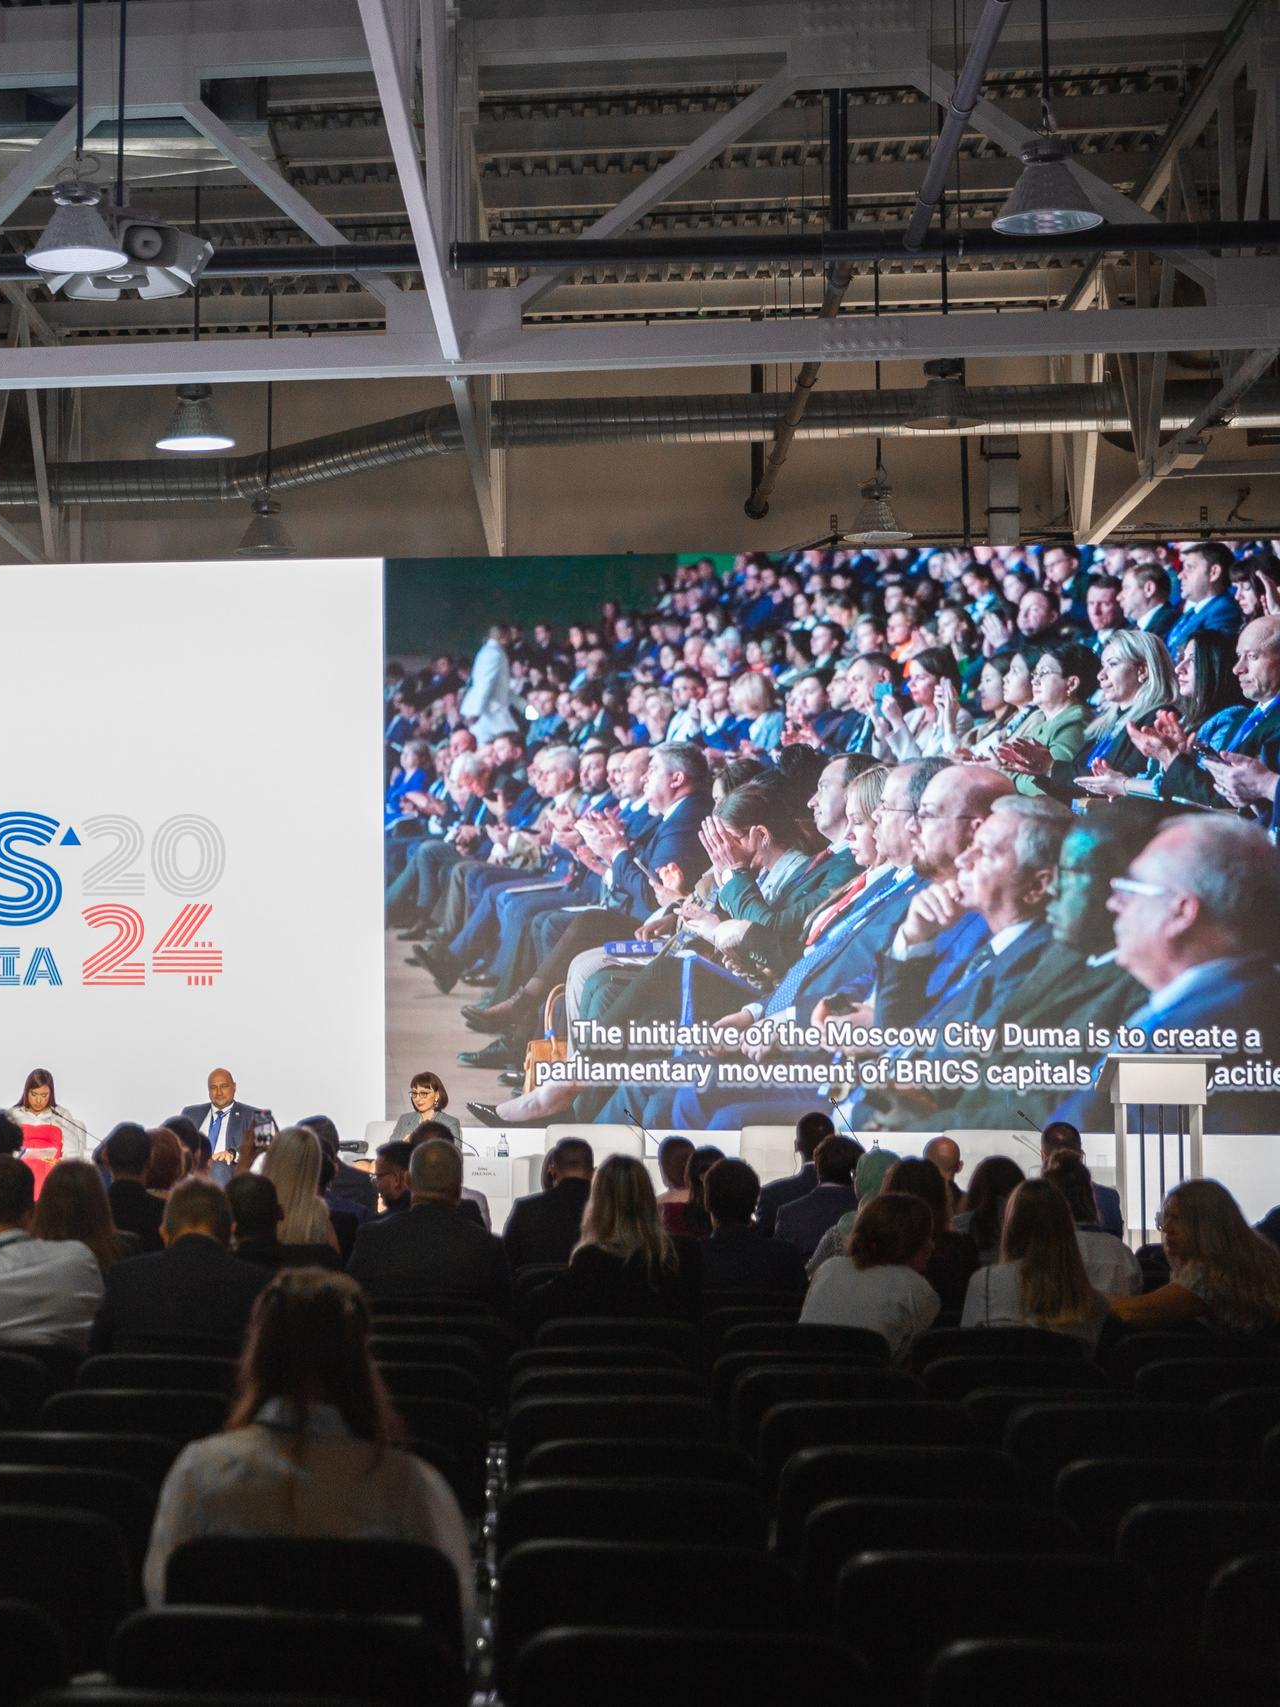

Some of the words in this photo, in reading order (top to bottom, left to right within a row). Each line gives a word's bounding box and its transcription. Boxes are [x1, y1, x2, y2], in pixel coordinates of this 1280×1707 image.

[80, 813, 227, 898] 20
[80, 903, 223, 986] 24
[573, 1020, 622, 1045] The
[629, 1020, 739, 1045] initiative
[745, 1020, 774, 1046] of
[777, 1020, 820, 1046] the
[827, 1021, 937, 1047] Moscow
[944, 1021, 996, 1052] City
[1004, 1022, 1081, 1047] Duma
[1088, 1022, 1111, 1047] is
[1117, 1024, 1145, 1047] to
[1152, 1024, 1237, 1047] create
[1244, 1028, 1261, 1047] a
[536, 1055, 712, 1087] parliamentary
[718, 1061, 855, 1083] movement
[861, 1058, 889, 1083] of
[896, 1059, 979, 1083] BRICS
[986, 1058, 1091, 1089] capitals
